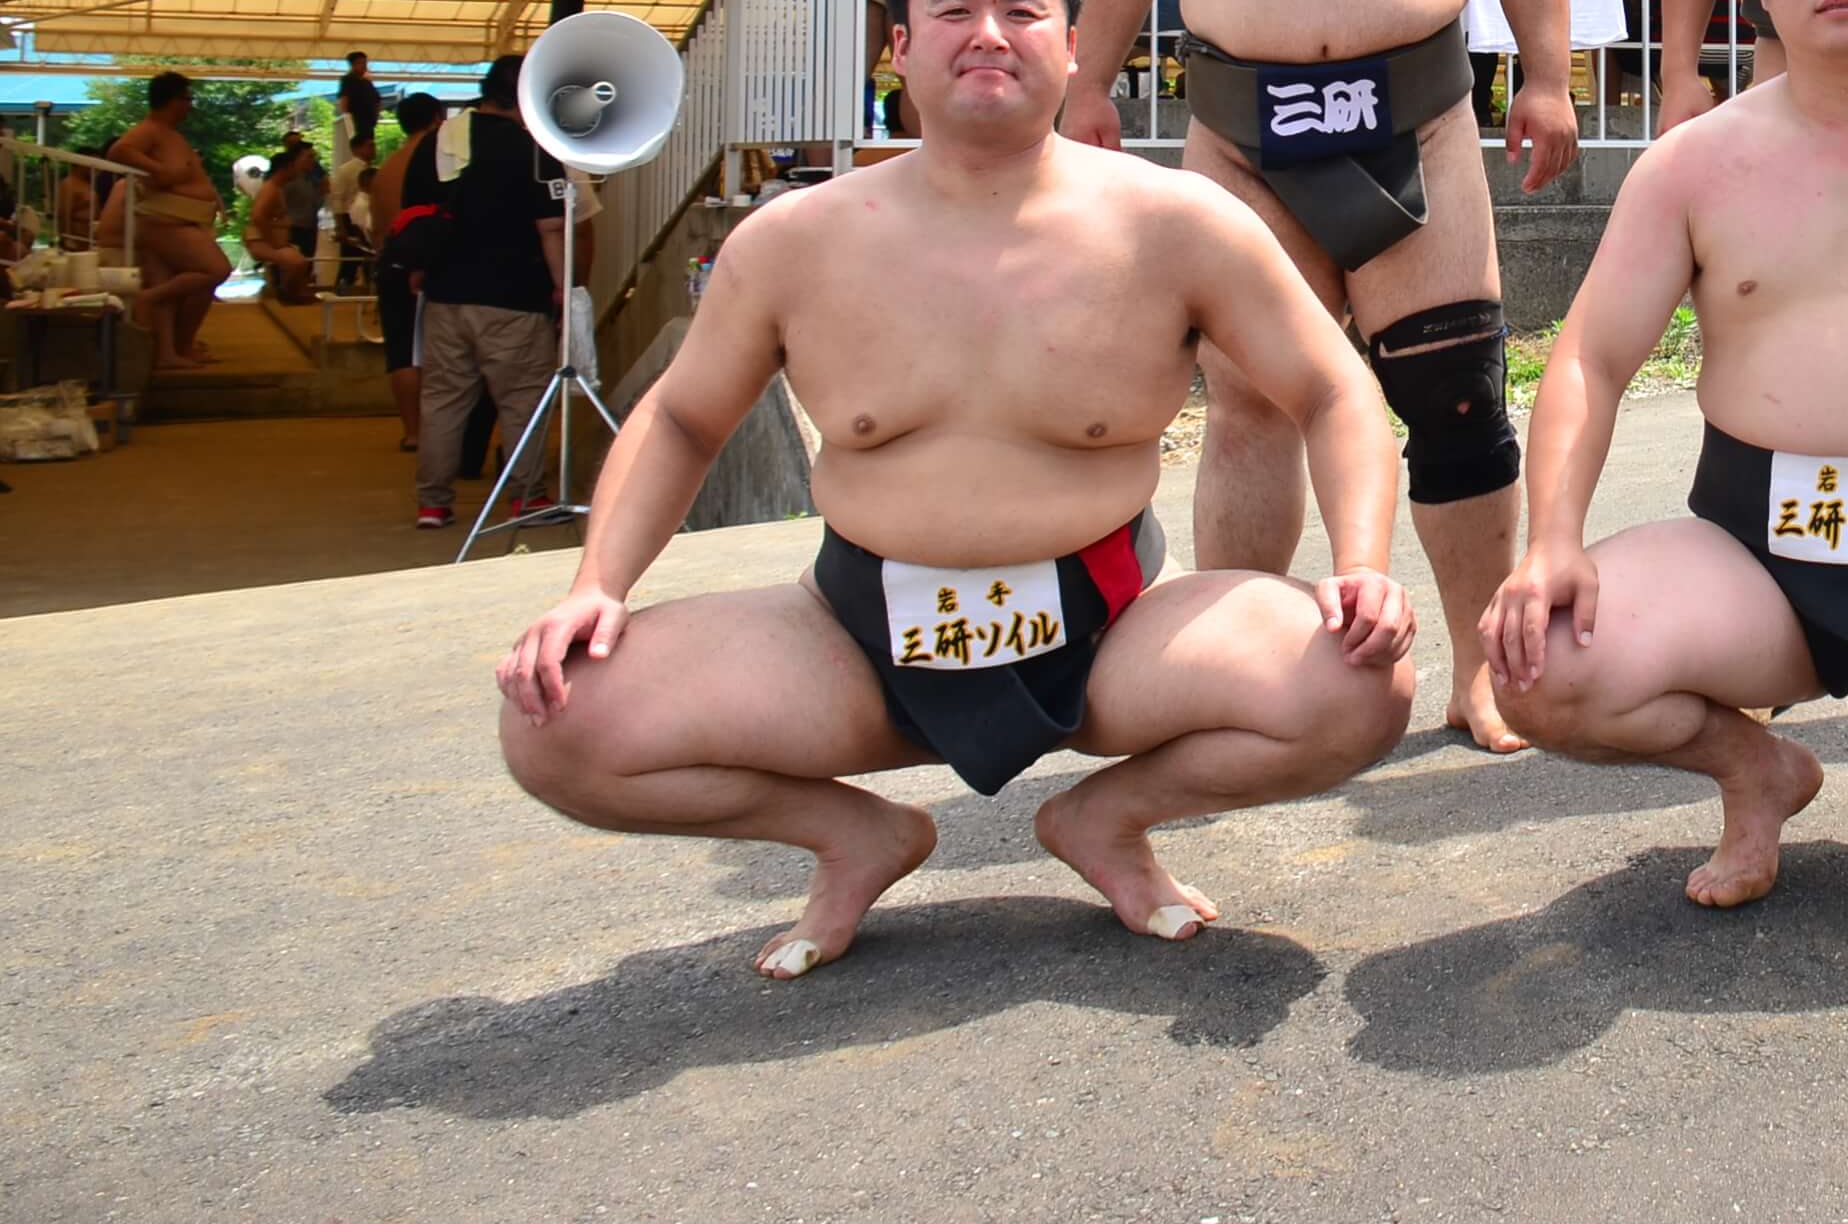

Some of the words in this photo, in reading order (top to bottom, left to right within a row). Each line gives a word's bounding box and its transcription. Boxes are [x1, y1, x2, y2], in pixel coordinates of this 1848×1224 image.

[899, 611, 1059, 665] 三研ソイル
